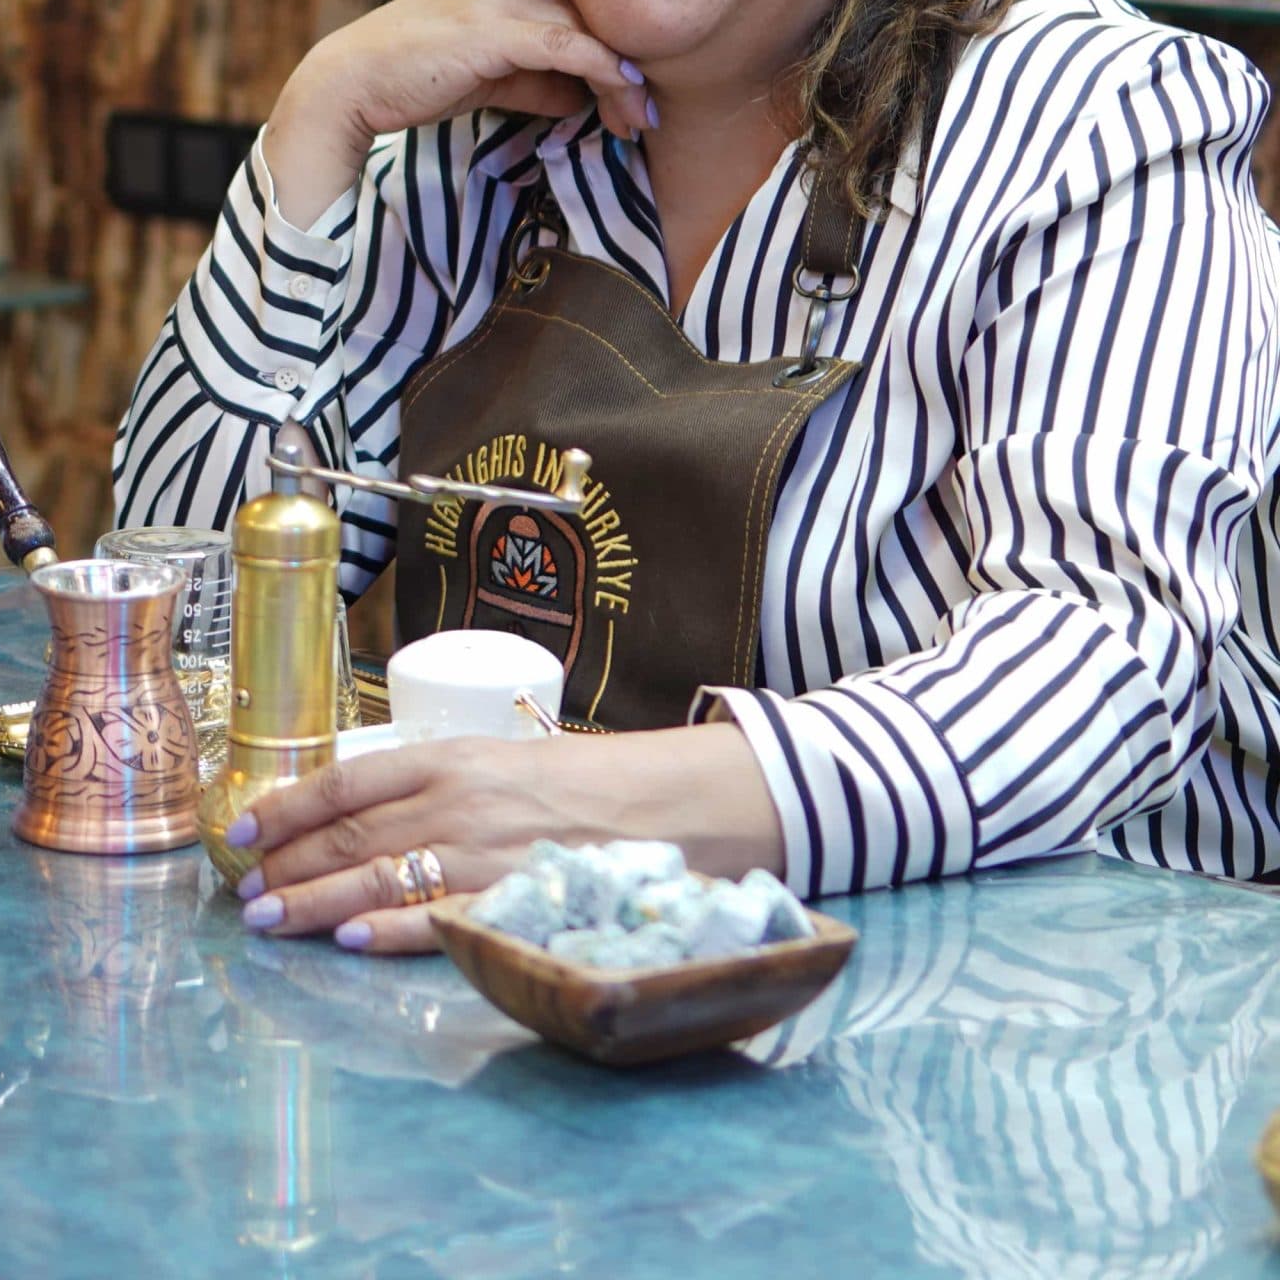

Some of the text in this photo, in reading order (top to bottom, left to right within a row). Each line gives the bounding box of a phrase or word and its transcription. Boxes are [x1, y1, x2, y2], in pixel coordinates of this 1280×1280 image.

[533, 442, 564, 493] IN
[183, 603, 202, 617] 50
[183, 629, 201, 644] 75
[180, 655, 203, 668] 100
